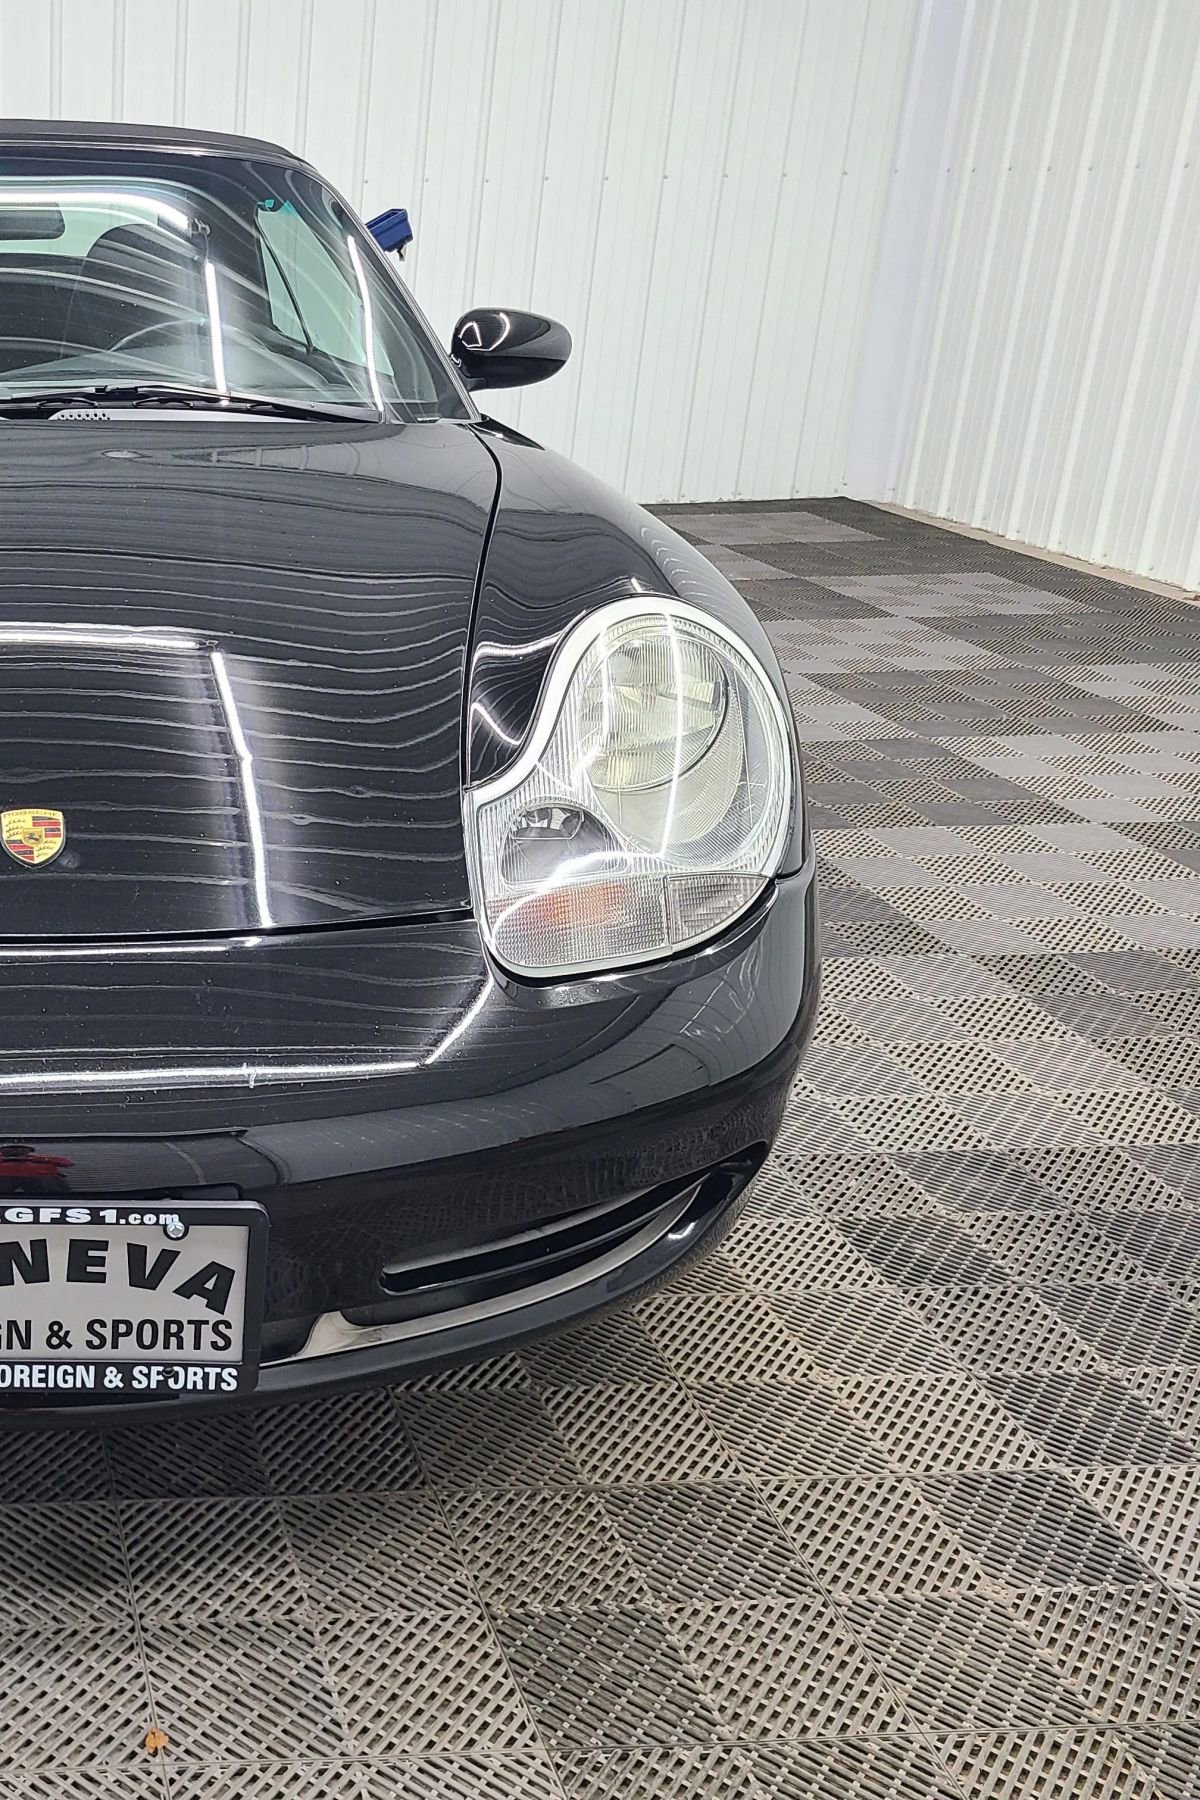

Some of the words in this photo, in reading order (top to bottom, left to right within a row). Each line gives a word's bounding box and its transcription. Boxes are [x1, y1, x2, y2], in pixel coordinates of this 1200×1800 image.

[45, 1319, 73, 1350] &
[85, 1318, 233, 1352] SPORTS
[103, 1365, 125, 1389] &
[131, 1365, 239, 1392] SPORTS
